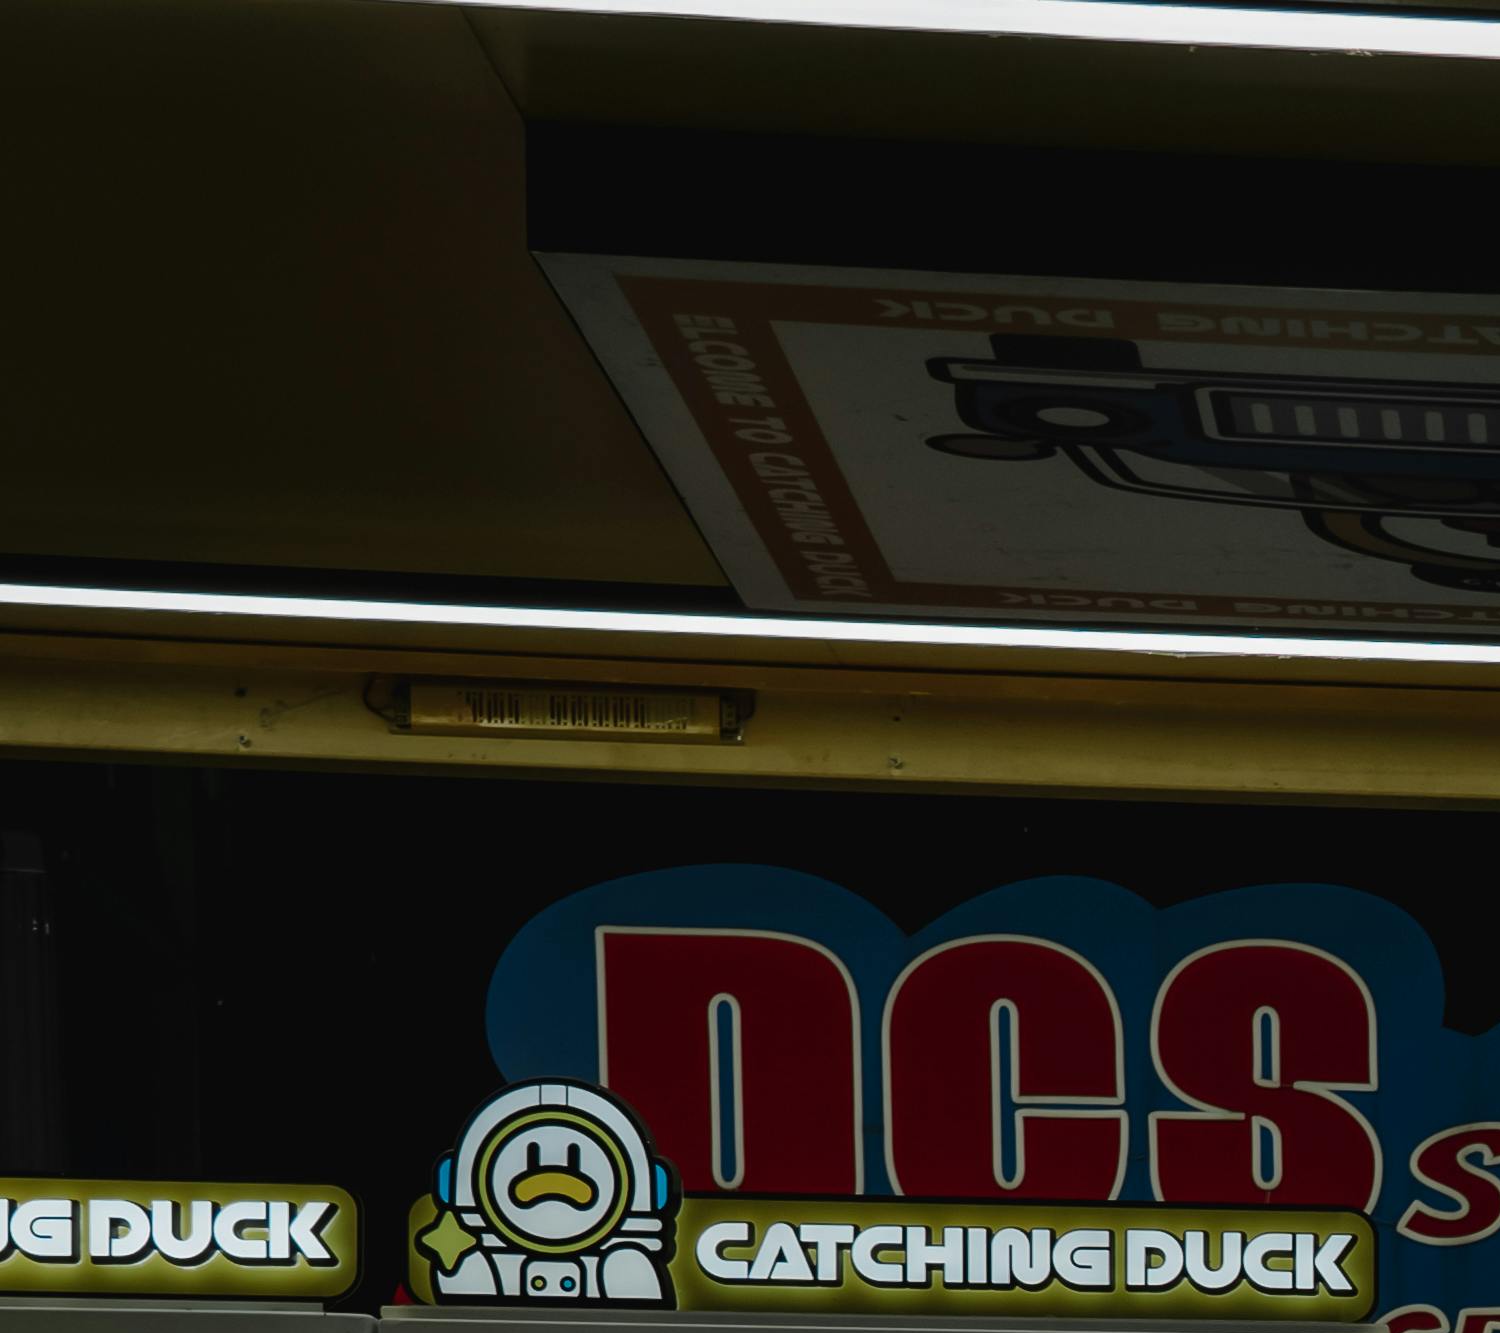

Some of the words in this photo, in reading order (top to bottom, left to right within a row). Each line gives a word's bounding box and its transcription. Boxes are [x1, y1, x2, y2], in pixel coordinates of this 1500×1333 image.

[880, 299, 1116, 330] DUCK
[748, 451, 845, 546] CATCHING
[801, 550, 872, 598] DUCK
[999, 591, 1199, 611] DUCK
[596, 926, 1382, 1210] DCS
[88, 1199, 338, 1268] DUCK
[696, 1219, 1113, 1291] CATCHING
[1126, 1224, 1358, 1294] DUCK
